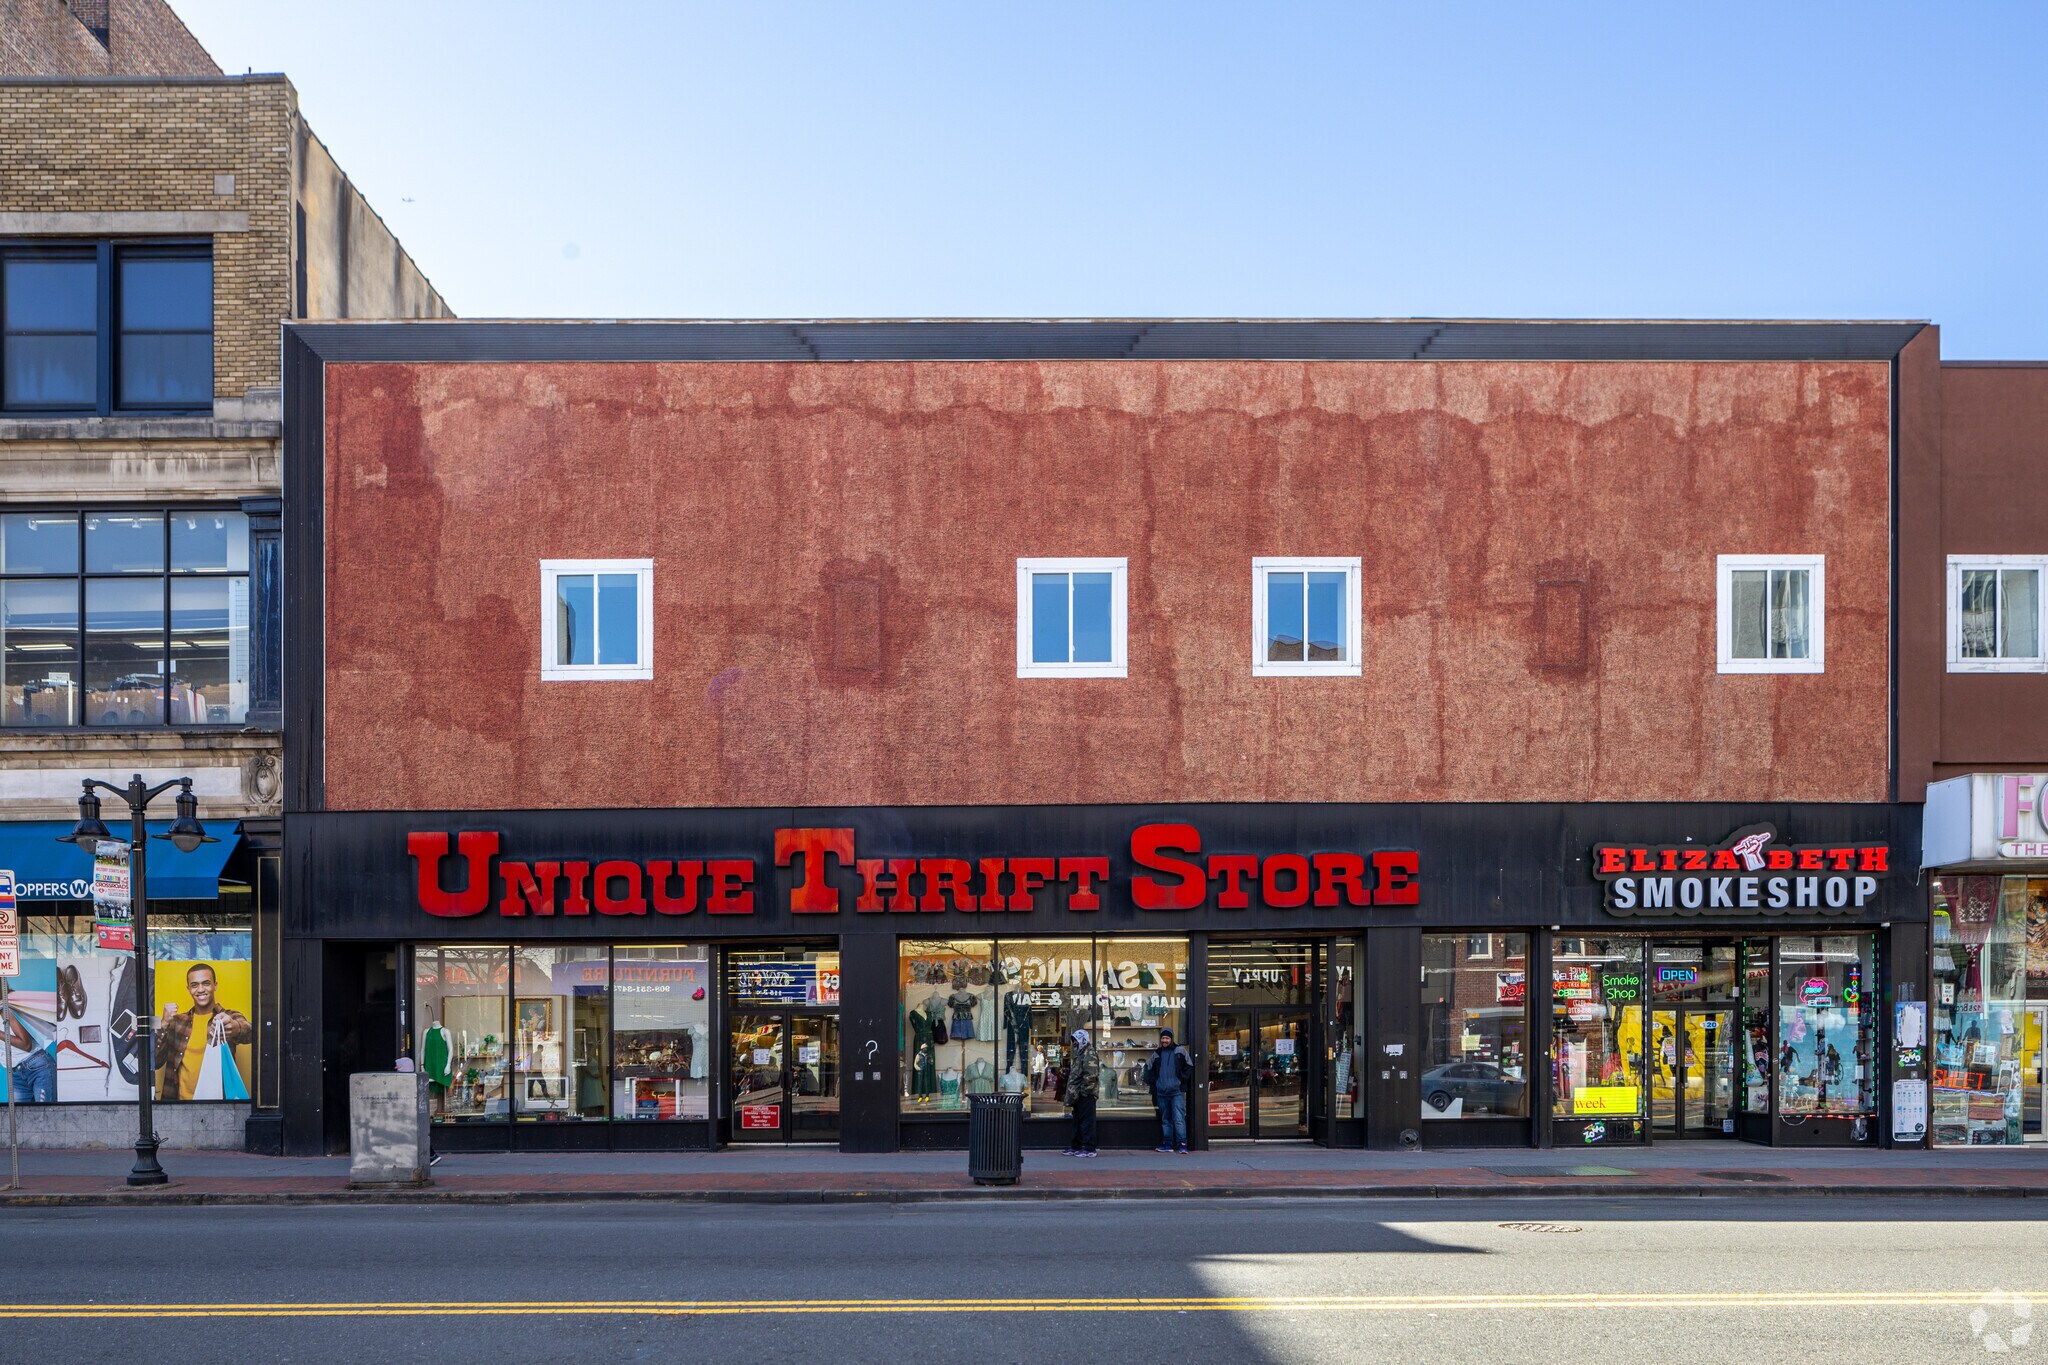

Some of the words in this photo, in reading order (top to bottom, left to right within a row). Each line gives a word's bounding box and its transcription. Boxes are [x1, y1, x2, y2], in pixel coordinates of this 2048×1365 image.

[408, 831, 754, 917] UNIQUE
[774, 827, 1110, 915] THRIFT
[1131, 823, 1420, 910] STORE
[15, 883, 68, 897] OPPERS
[1614, 876, 1877, 909] SMOKESHOP
[1603, 974, 1640, 986] Smoke
[1662, 970, 1694, 981] OPEN
[1607, 988, 1636, 1000] Shop
[1575, 1097, 1606, 1109] week
